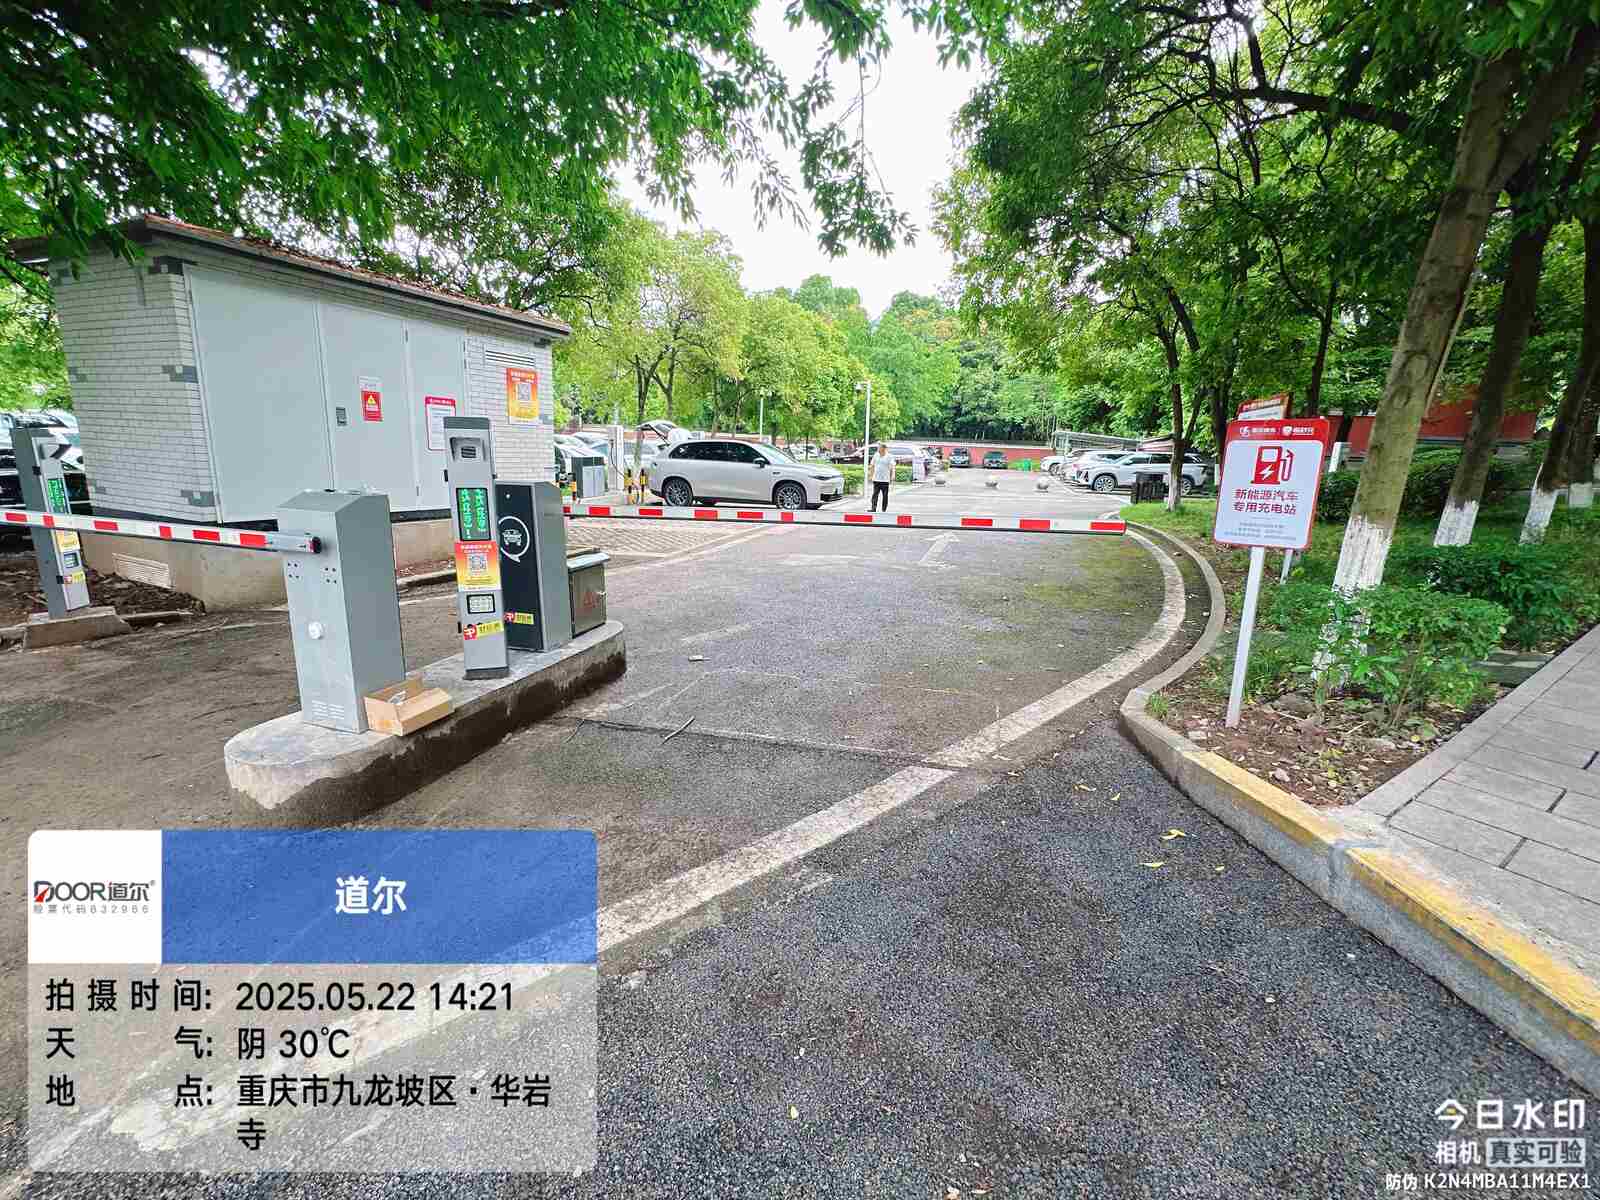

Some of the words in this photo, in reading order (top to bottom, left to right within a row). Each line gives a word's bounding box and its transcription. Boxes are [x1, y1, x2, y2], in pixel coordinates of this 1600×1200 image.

[1234, 488, 1299, 501] 新能源汽车
[1233, 501, 1297, 515] 专用充电站
